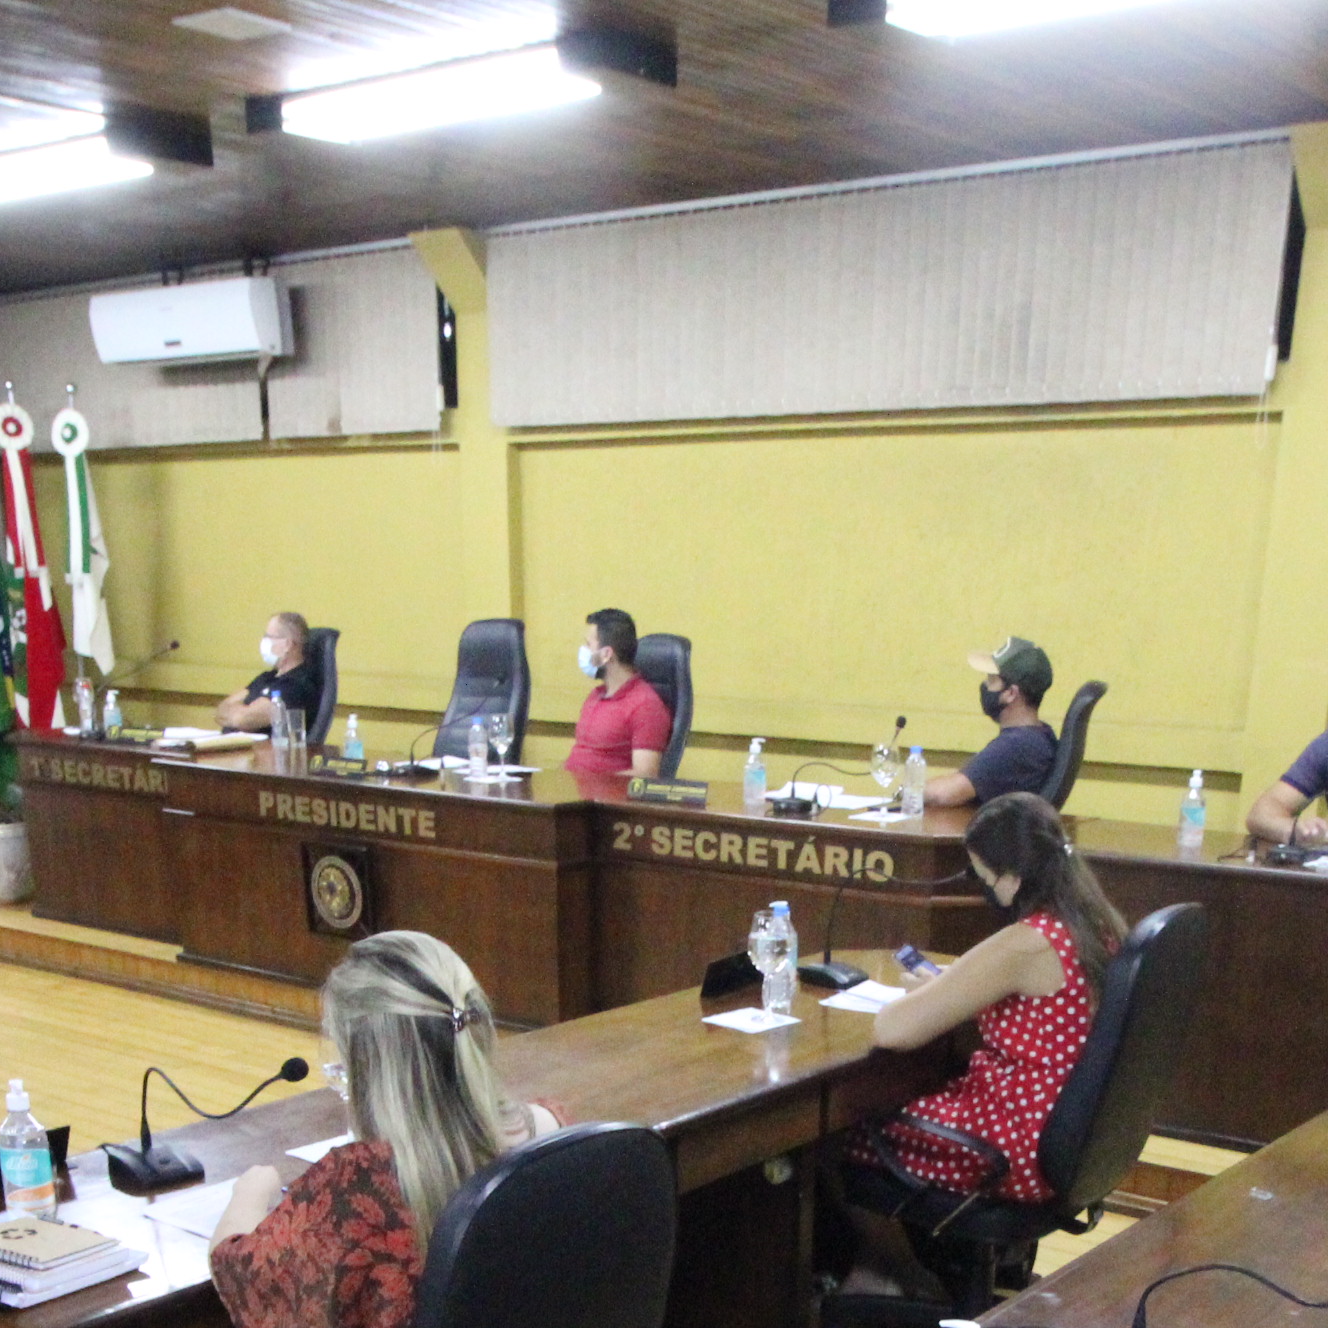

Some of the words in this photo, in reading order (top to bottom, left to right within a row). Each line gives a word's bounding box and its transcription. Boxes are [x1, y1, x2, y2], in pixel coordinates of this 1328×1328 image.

[50, 758, 169, 794] SECRETÁRI
[259, 790, 436, 839] PRESIDENTE
[651, 825, 895, 883] SECRETÁRIO
